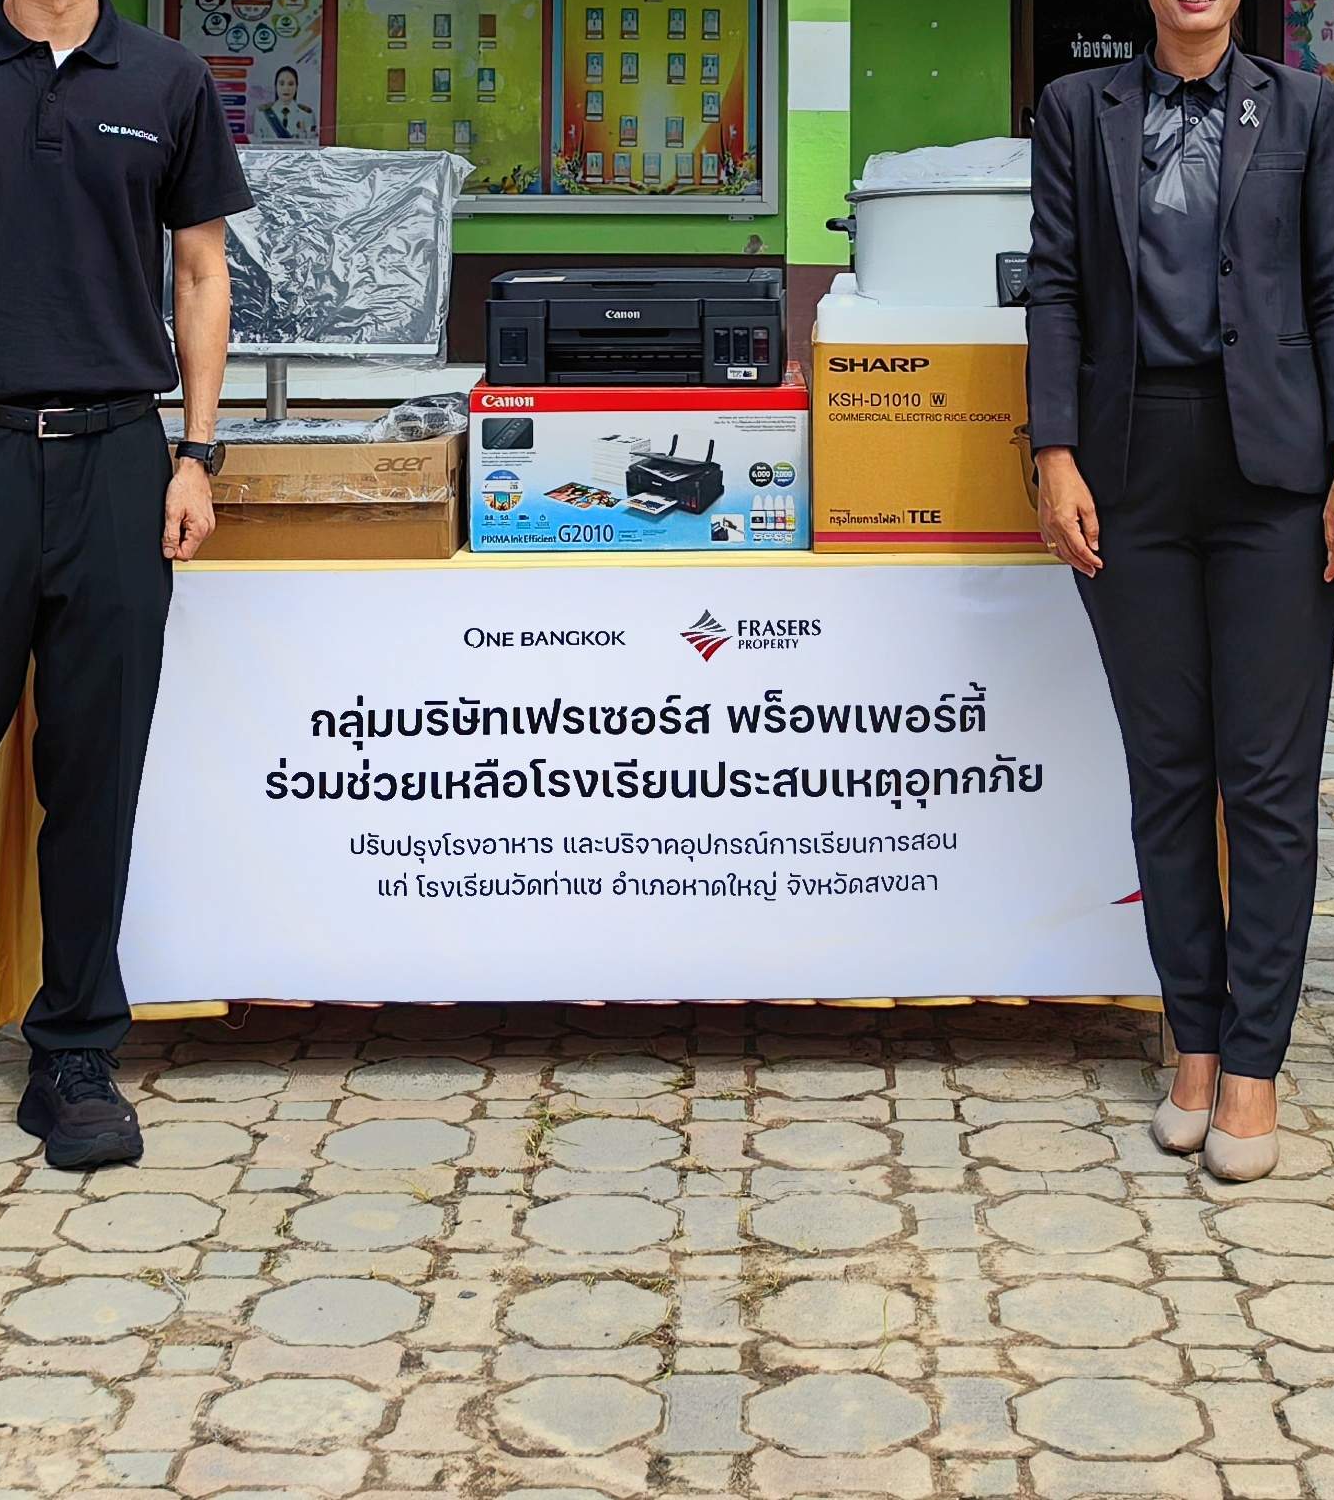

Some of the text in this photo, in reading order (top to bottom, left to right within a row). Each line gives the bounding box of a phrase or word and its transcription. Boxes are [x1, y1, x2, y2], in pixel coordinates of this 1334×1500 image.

[99, 124, 158, 143] ONE BANGKOK
[605, 310, 641, 319] Canon
[829, 357, 930, 373] SHARP
[481, 394, 534, 408] Canon
[829, 393, 946, 407] KSH-D1010 W
[829, 412, 1011, 422] COMMERCIAL ELECTRIC RICE COOKER
[374, 456, 432, 472] acer
[829, 509, 942, 527] กรุงไทยการไฟฟ้า TCE
[481, 534, 511, 544] PIXMA
[511, 534, 523, 544] Ink
[523, 534, 556, 544] Efficient
[558, 524, 614, 543] G2010
[738, 619, 822, 637] FRASERS
[463, 627, 627, 649] ONE BANGKOK
[738, 639, 799, 650] PROPERTY
[311, 682, 987, 751] กลุ่มบริษัทเฟรเซอร์ส พร็อพเพอร์ตี้
[266, 754, 1043, 809] ร่วมช่วยเหลือโรงเรียนประสบเหตุอุทกภัย
[350, 831, 957, 864] ปรับปรุงโรงอาหาร และบริจาคอุปกรณ์การเรียนการสอน
[378, 870, 938, 902] แก่ โรงเรียนวัดท่าแซ อำเภอหาดใหญ่ จังหวัดสงขลา
